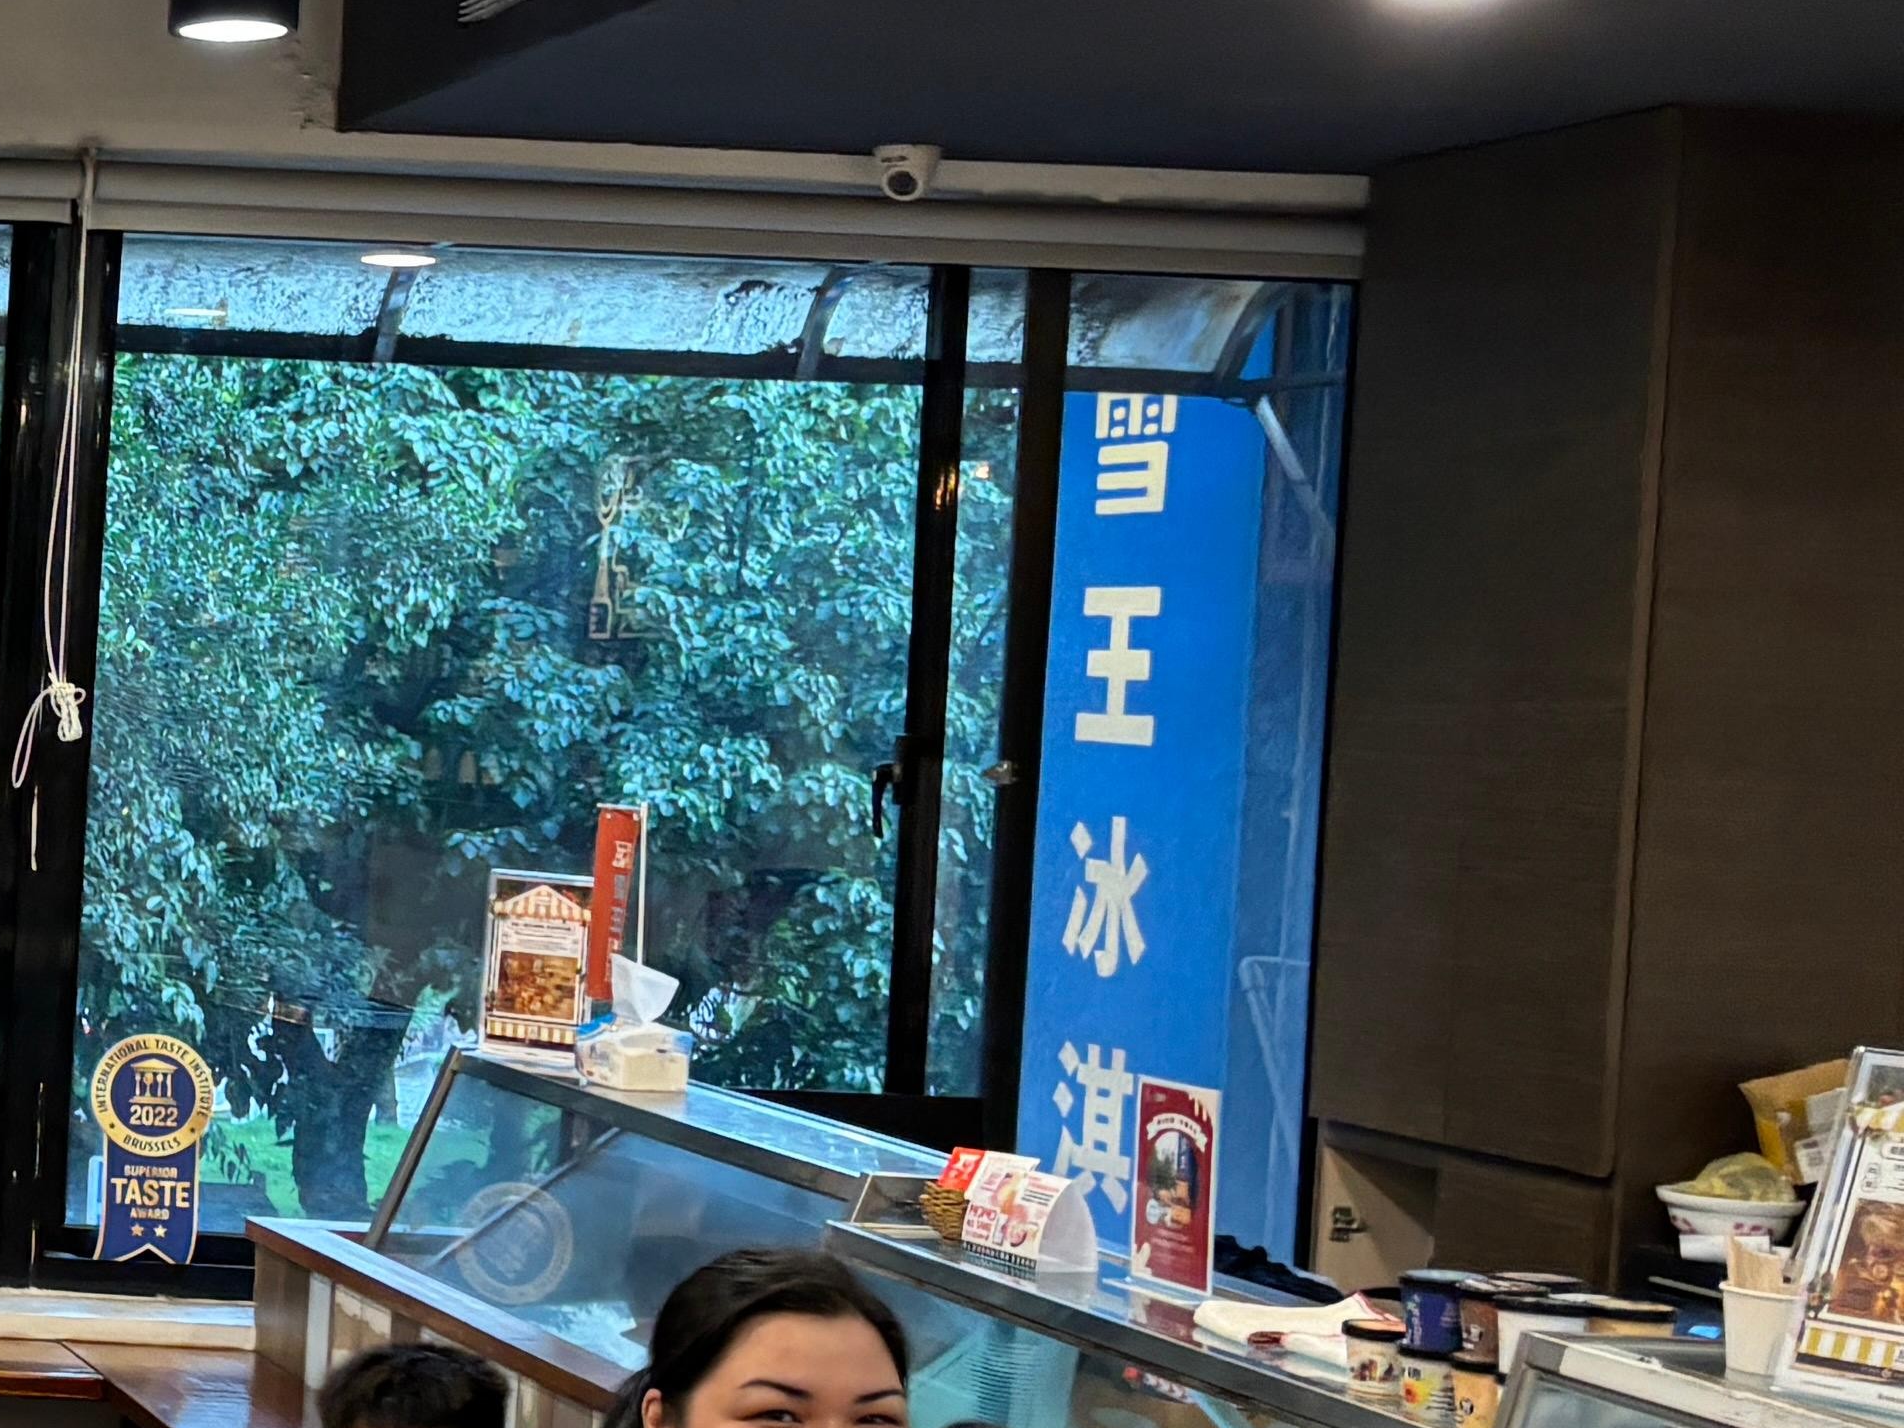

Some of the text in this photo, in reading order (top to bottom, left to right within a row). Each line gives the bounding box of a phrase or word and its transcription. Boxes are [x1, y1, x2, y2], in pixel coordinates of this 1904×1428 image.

[95, 1038, 213, 1116] INTERNATIONAL TASTE INSTITUTE
[129, 1105, 178, 1127] 2022
[123, 1134, 182, 1153] BRUSSELS
[124, 1164, 178, 1179] SUPERIOR
[111, 1178, 190, 1208] TASTE
[130, 1208, 170, 1221] AWARD
